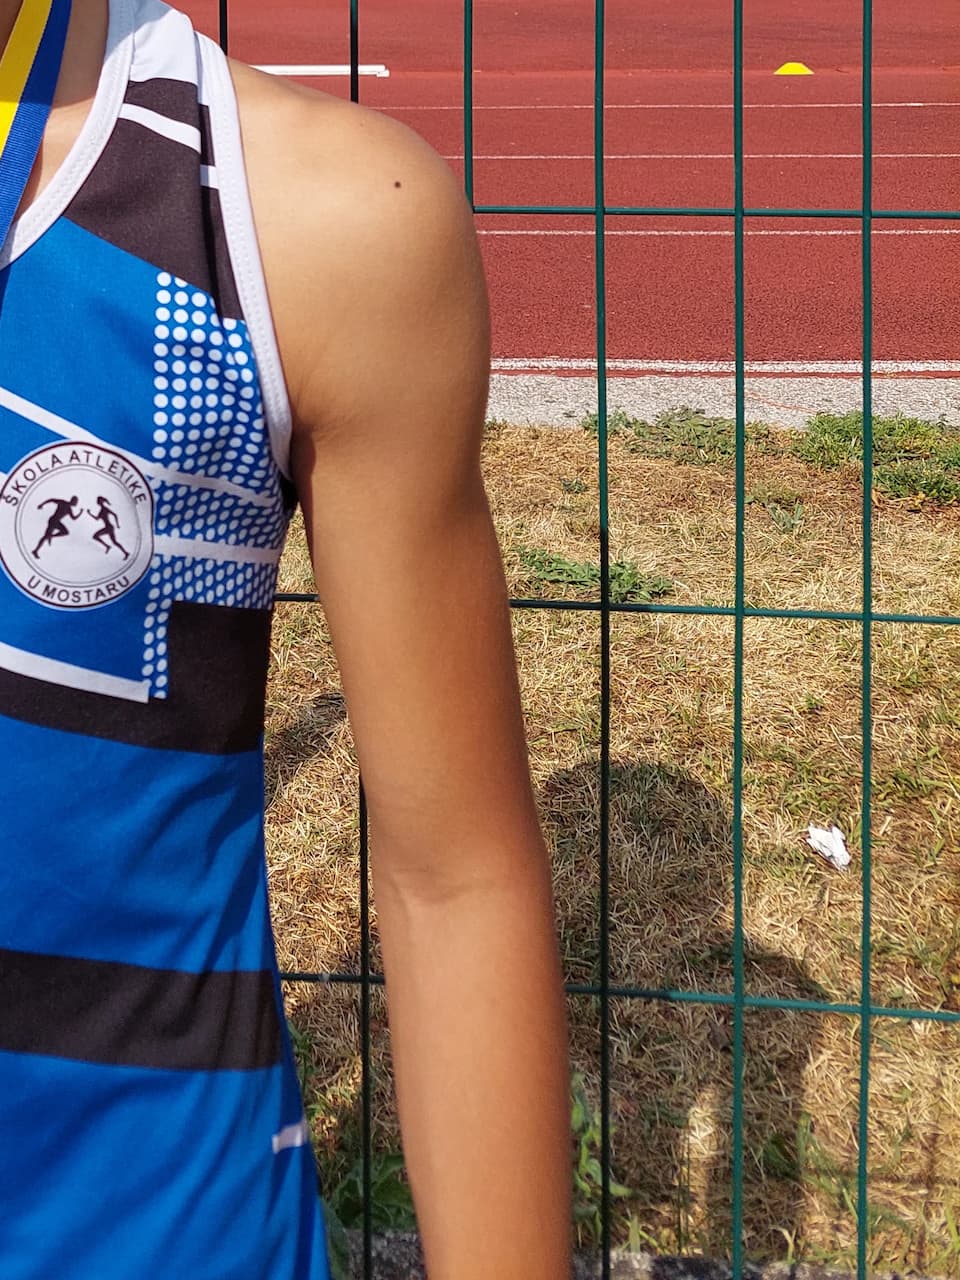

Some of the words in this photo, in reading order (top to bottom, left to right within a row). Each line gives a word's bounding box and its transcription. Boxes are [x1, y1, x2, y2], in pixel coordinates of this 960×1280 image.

[3, 452, 62, 507] ŠKOLA
[69, 450, 147, 505] ATLETIKE
[27, 575, 41, 590] U
[42, 575, 131, 604] MOSTARU
